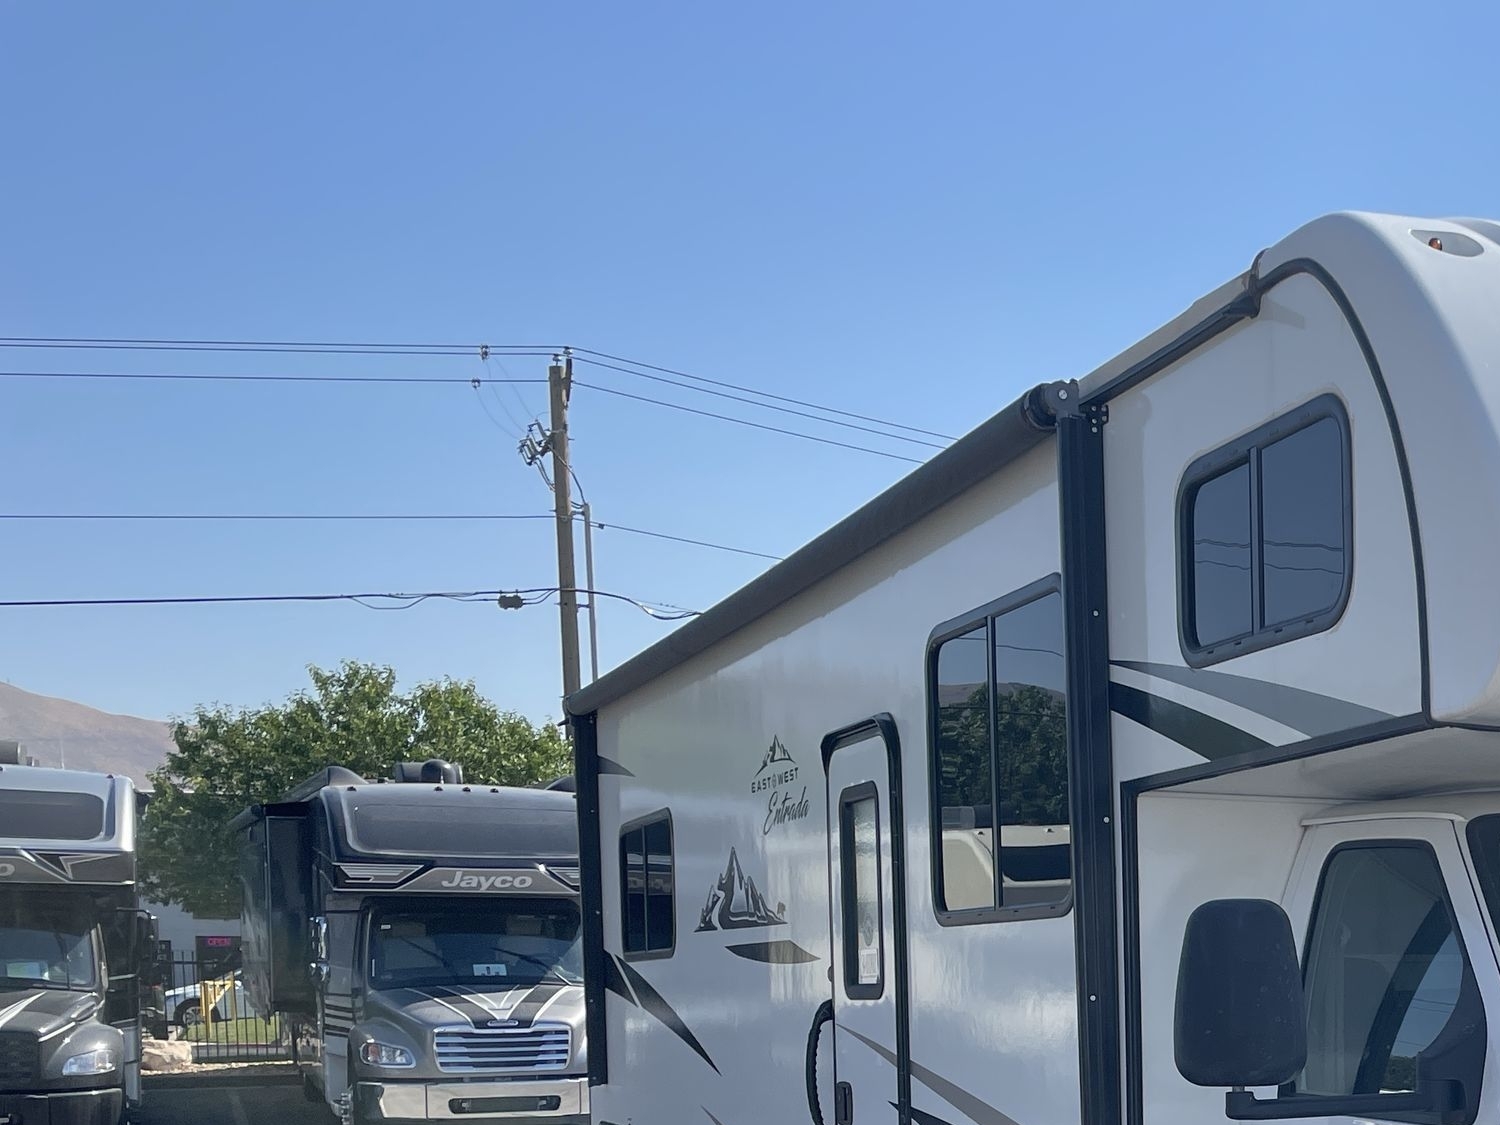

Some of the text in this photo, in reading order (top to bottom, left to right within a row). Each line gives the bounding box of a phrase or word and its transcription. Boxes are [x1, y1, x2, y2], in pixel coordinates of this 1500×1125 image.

[752, 777, 771, 793] EAST
[777, 767, 798, 785] WEST
[763, 786, 809, 835] Entrada
[441, 871, 532, 891] Jayco
